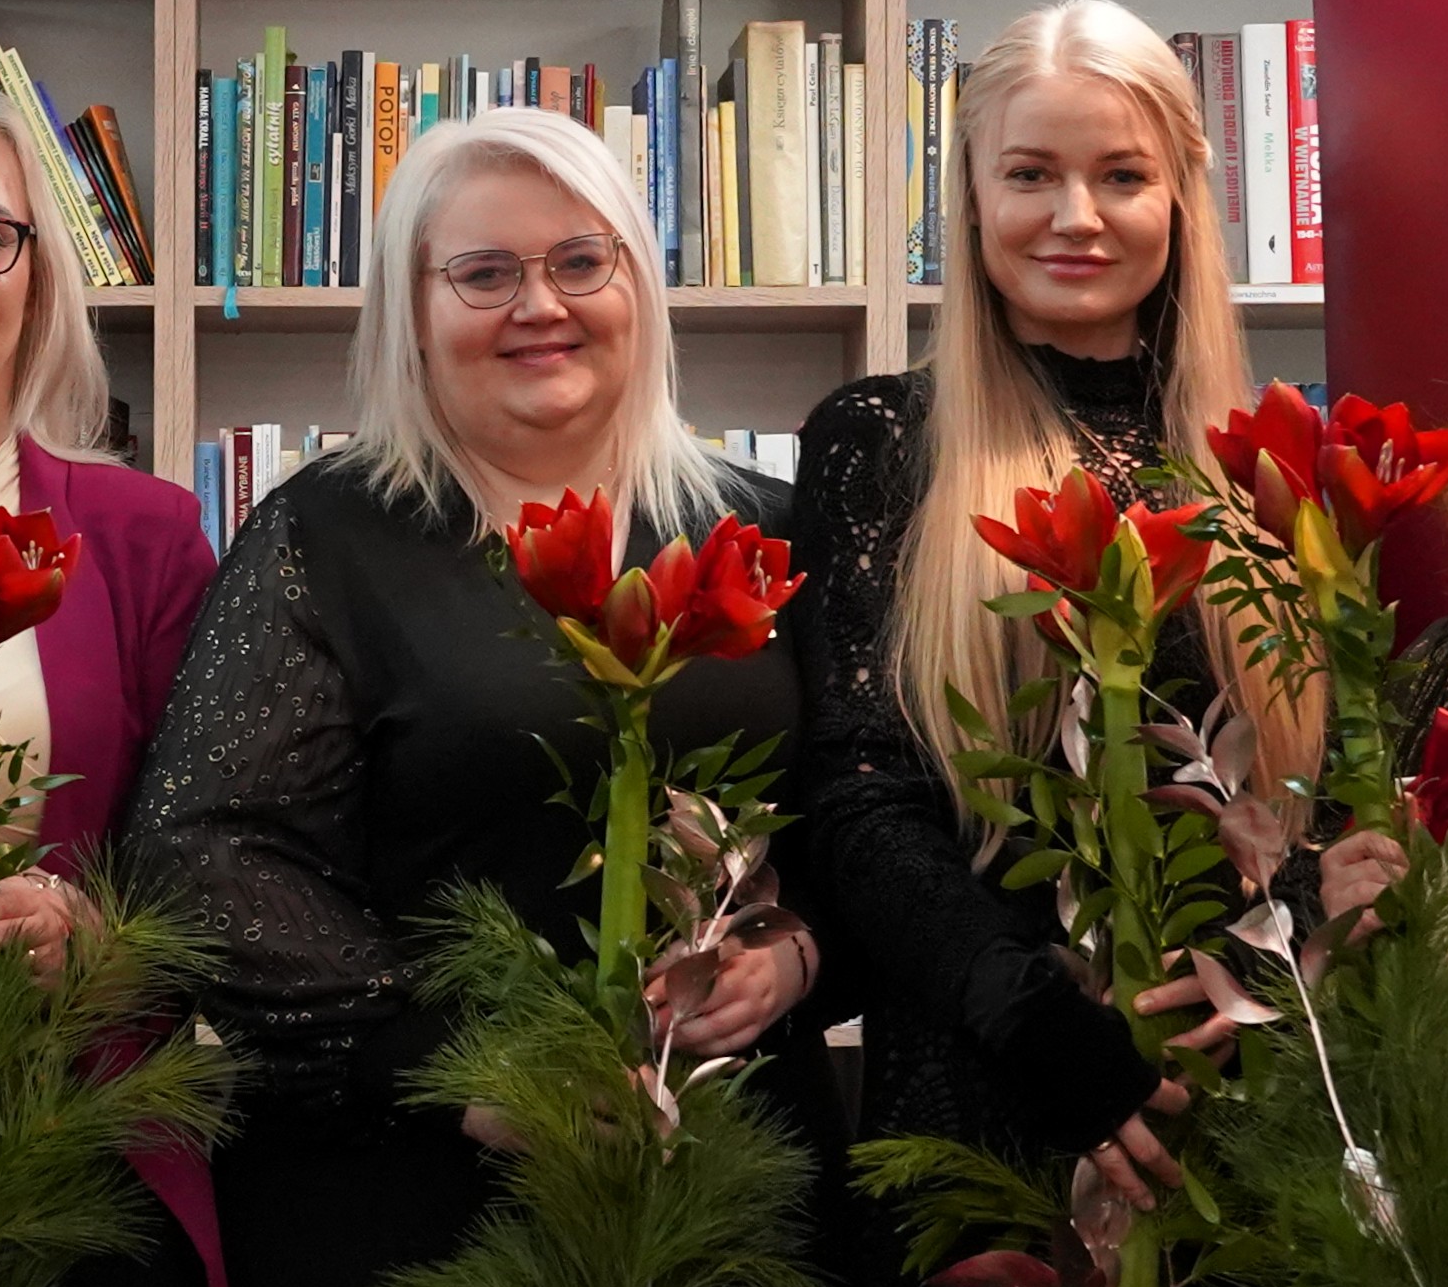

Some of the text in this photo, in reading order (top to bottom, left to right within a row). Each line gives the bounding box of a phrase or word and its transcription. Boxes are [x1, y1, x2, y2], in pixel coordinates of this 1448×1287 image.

[809, 61, 818, 107] Paul Celan
[927, 27, 938, 137] SIMON SEBAG MONTEFIORE
[199, 86, 210, 150] HANNA KRALL
[379, 85, 395, 156] POTOP
[1223, 104, 1237, 153] UPADEK
[1263, 131, 1273, 174] Mekka
[1295, 141, 1309, 226] WIETNAMIE
[237, 455, 249, 501] WYBRANE
